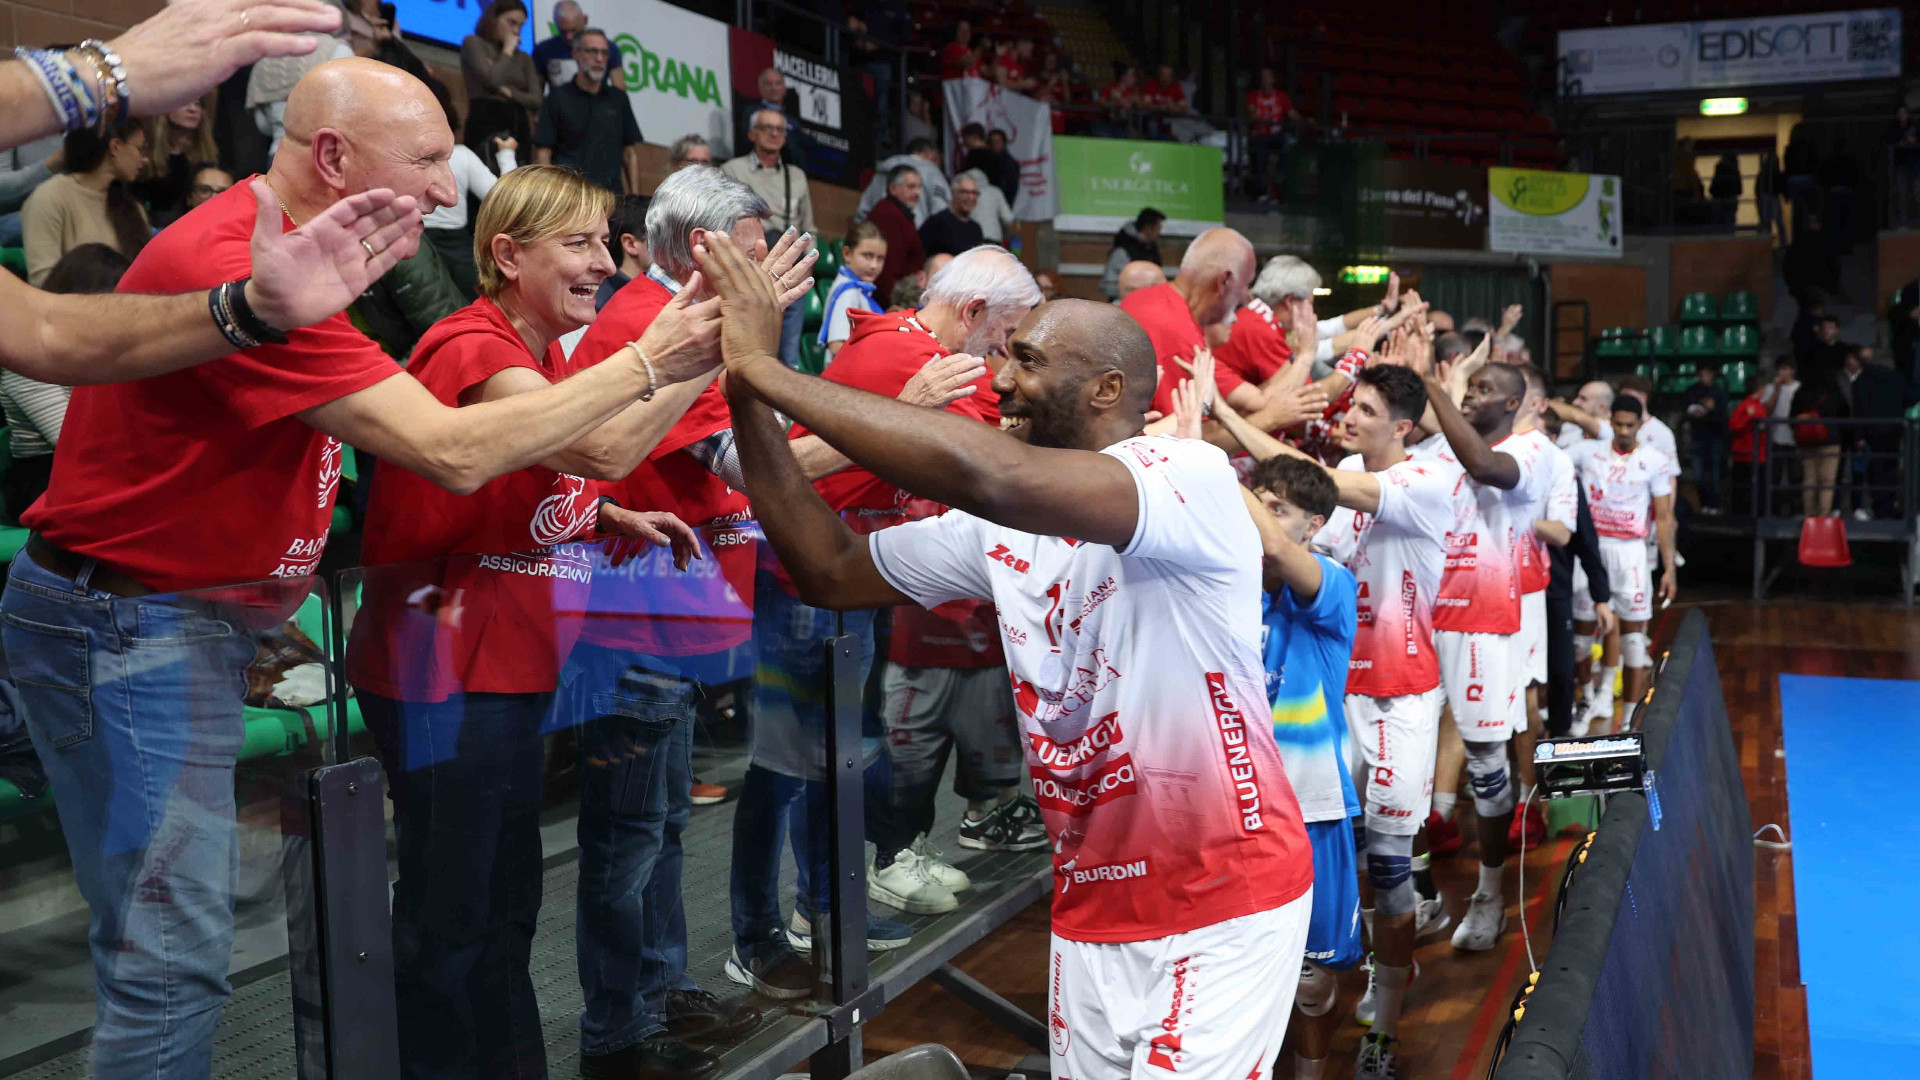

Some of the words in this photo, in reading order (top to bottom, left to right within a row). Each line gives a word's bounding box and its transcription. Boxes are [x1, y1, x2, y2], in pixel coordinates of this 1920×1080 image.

[1698, 21, 1845, 62] EDISOFT
[616, 36, 723, 108] GRANA
[773, 48, 840, 93] MACELLERIA
[1091, 176, 1189, 194] ENERGETICA
[1607, 465, 1627, 485] 22
[986, 543, 1030, 574] Zeu
[1475, 720, 1505, 728] Zeus
[1210, 680, 1264, 832] BLUENERGY
[1377, 805, 1412, 817] Zeus
[1053, 951, 1062, 1012] granelli
